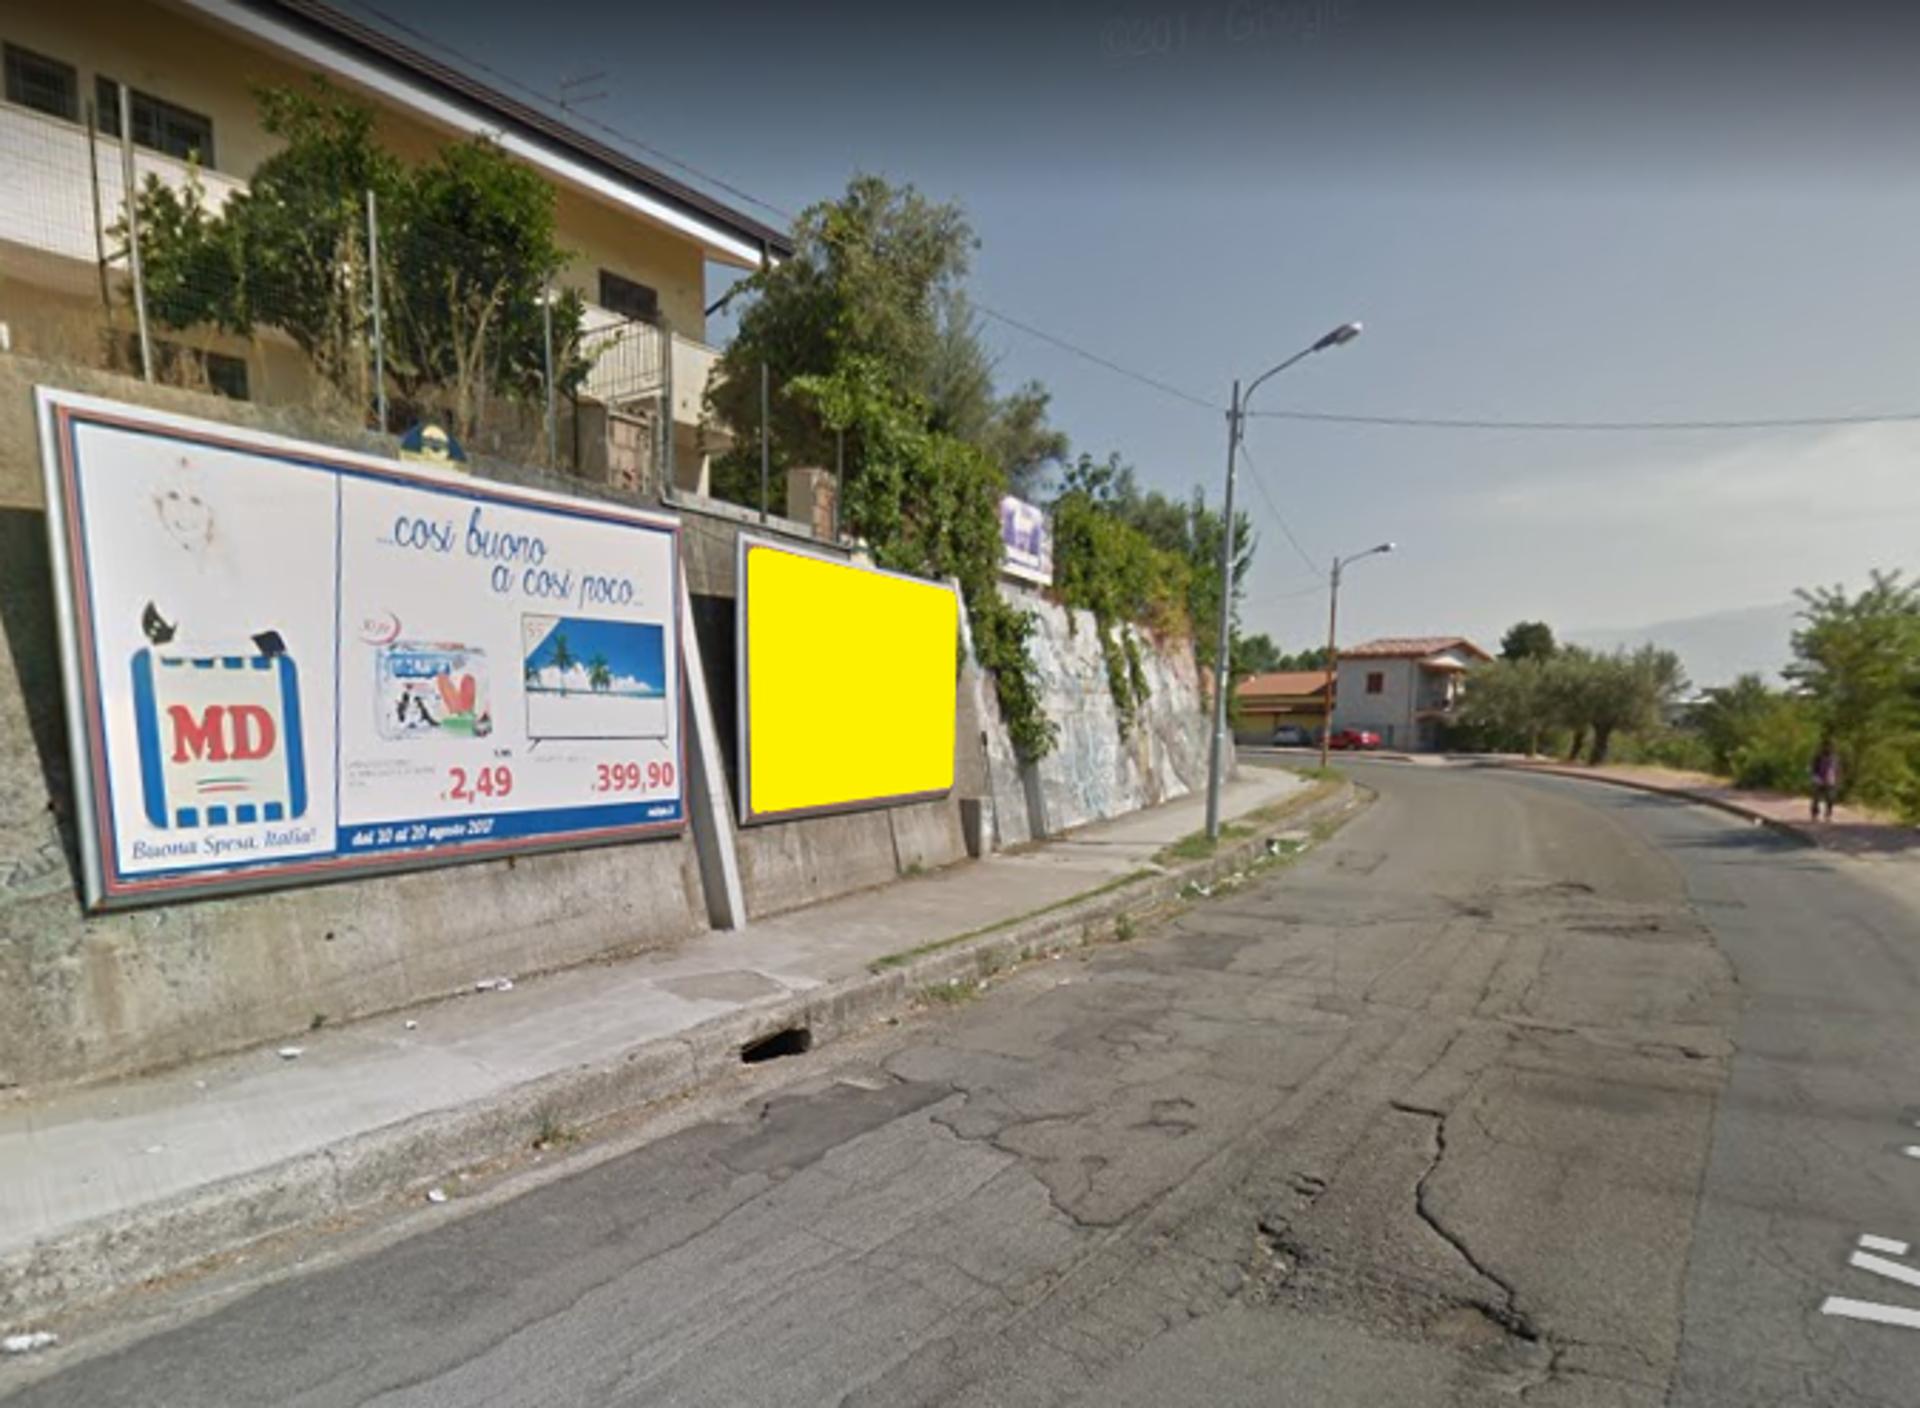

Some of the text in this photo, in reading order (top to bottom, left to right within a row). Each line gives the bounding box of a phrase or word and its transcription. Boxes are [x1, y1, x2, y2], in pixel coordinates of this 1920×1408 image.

[465, 506, 547, 565] buono
[491, 564, 513, 593] a
[166, 704, 276, 763] MD
[429, 823, 466, 842] agosto
[131, 838, 198, 860] Buona
